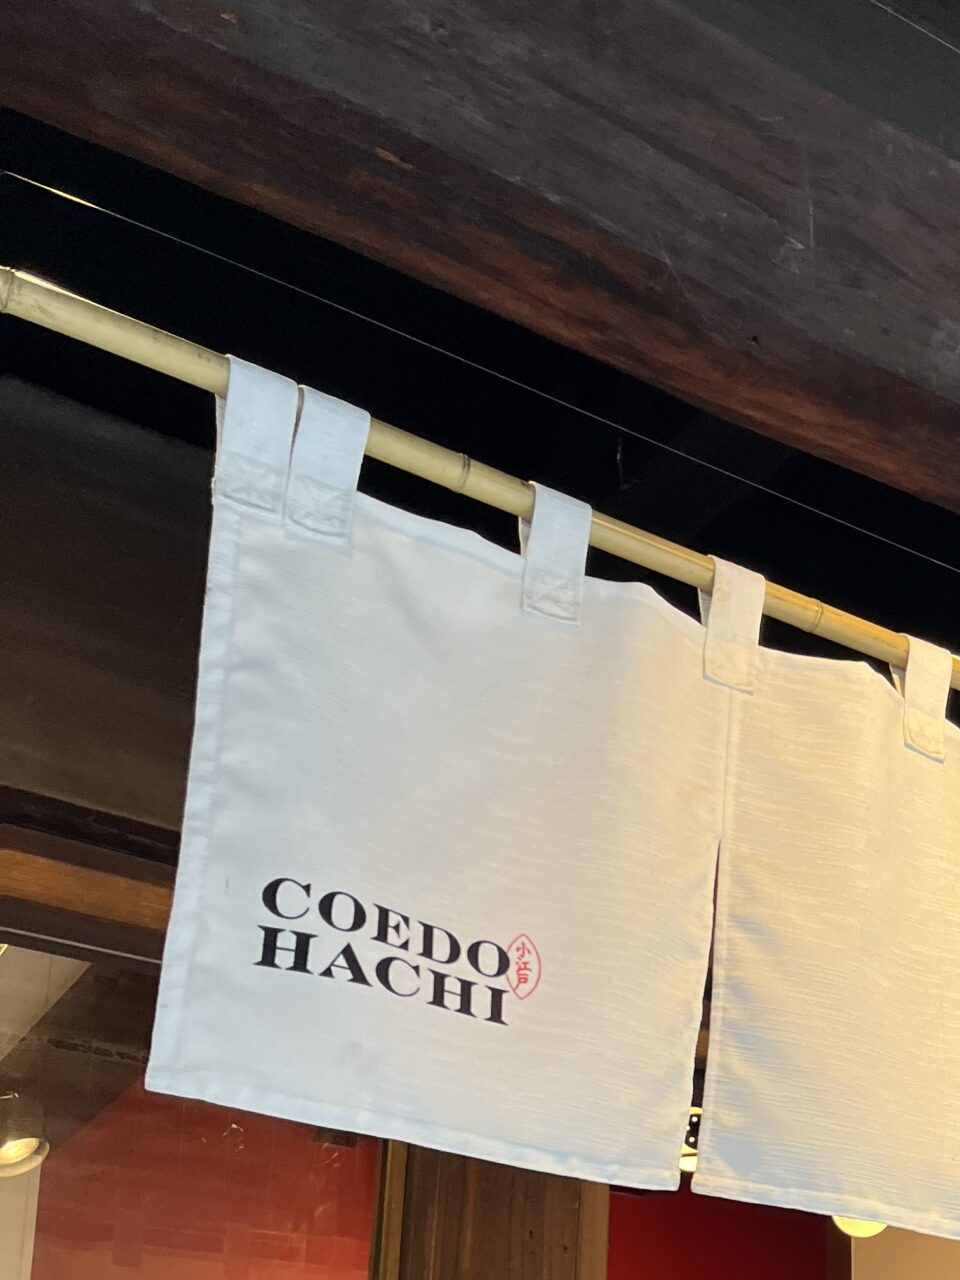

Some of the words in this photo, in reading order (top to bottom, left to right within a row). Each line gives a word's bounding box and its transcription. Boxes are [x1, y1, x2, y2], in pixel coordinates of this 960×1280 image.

[252, 924, 511, 1026] HACHI
[262, 877, 511, 978] COEDO
[513, 940, 535, 992] 小江戸
